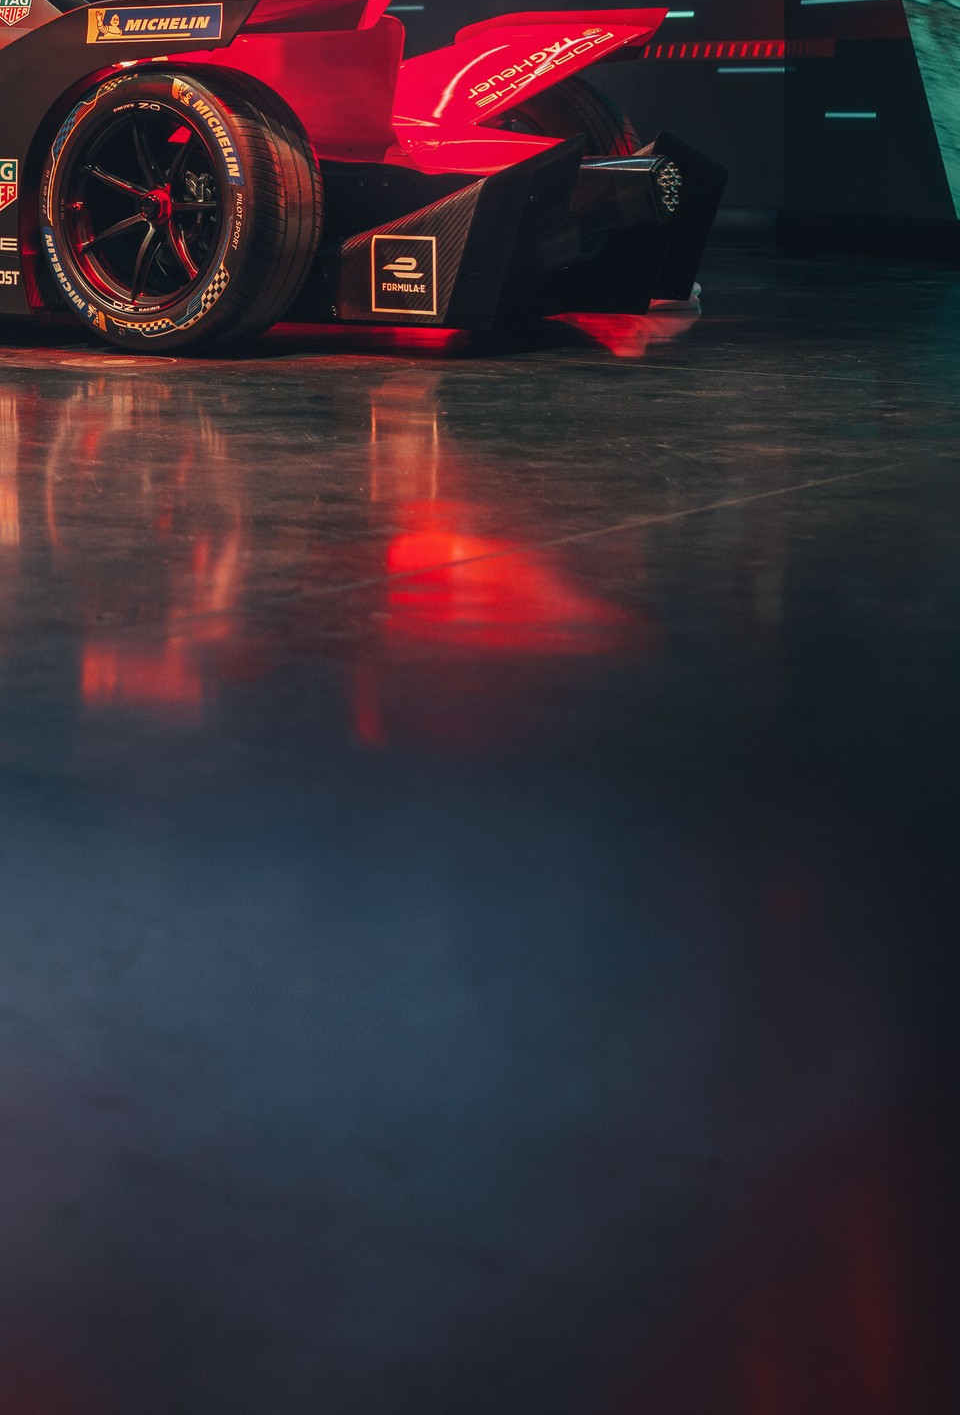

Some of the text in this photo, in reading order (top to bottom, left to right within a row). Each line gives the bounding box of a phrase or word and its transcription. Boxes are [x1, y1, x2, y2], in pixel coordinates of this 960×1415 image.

[124, 15, 210, 31] MICHELIN
[468, 37, 576, 99] TAGHeuer
[475, 32, 614, 108] PORSCHE
[192, 99, 240, 177] MICHELIN
[232, 193, 243, 250] PILOT SPORT
[45, 234, 86, 310] MICHELIN
[381, 282, 426, 294] FORMULA-E
